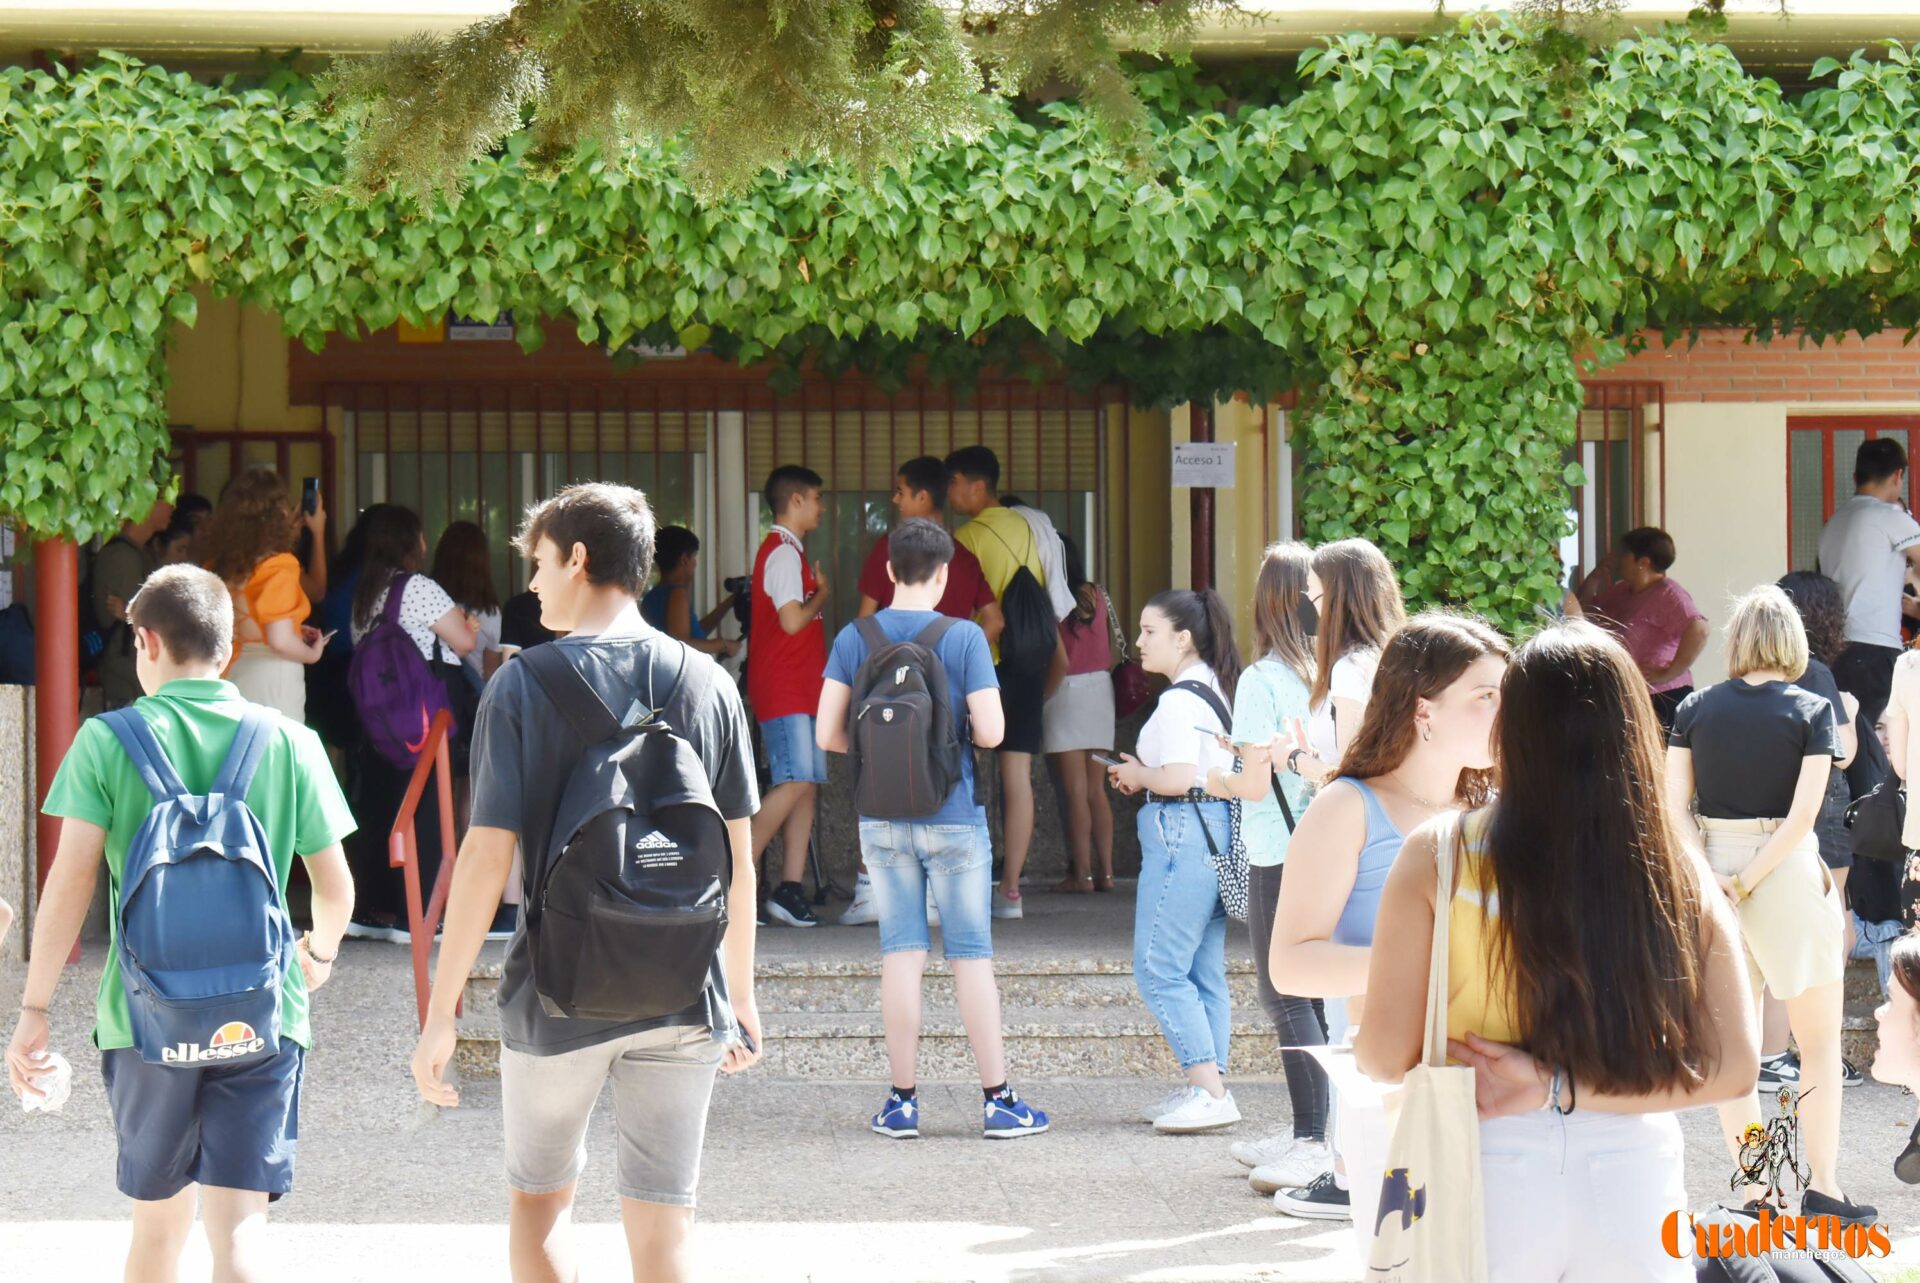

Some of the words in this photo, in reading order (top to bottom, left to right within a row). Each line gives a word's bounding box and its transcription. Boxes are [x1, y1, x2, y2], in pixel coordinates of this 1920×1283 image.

[1175, 455, 1213, 465] Acceso
[1217, 455, 1222, 465] 1
[635, 840, 678, 850] adidas
[161, 1037, 265, 1062] ellesse
